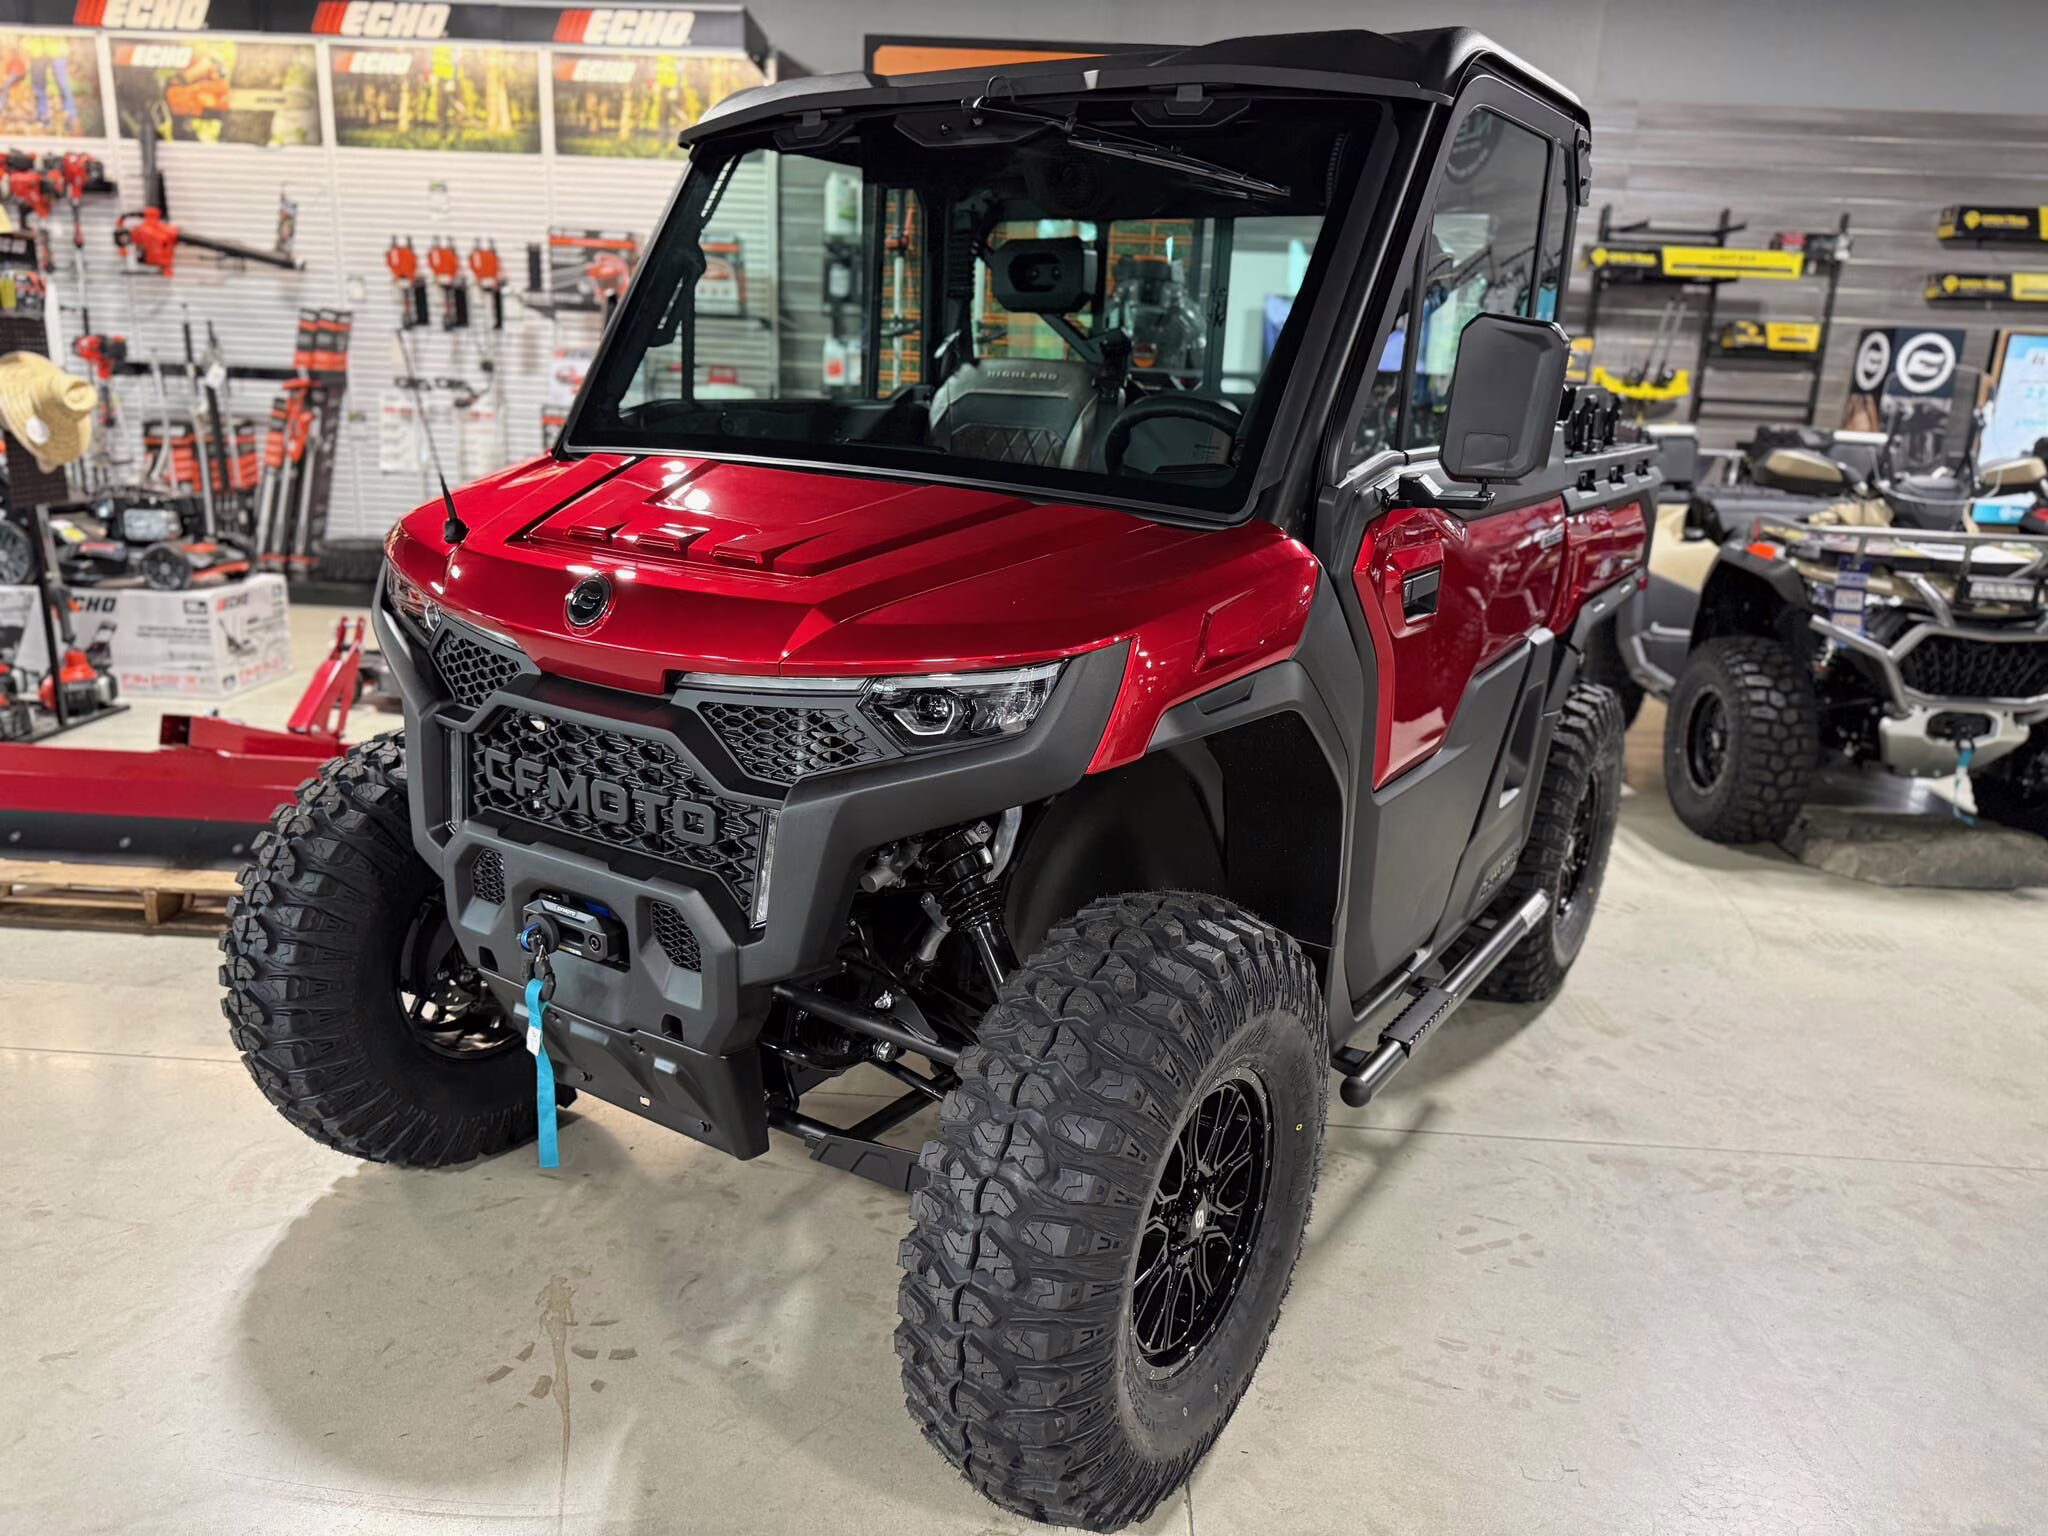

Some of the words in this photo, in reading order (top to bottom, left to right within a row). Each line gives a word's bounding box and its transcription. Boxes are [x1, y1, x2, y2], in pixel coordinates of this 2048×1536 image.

[102, 0, 210, 30] ECHO
[341, 1, 451, 38] ECHO
[583, 9, 695, 46] ECHO
[131, 45, 193, 68] ECHO
[350, 52, 413, 75] ECHO
[572, 59, 637, 83] ECHO
[987, 369, 1058, 380] HIGHLAND
[72, 596, 117, 612] CHO
[484, 747, 718, 847] CFMOTO
